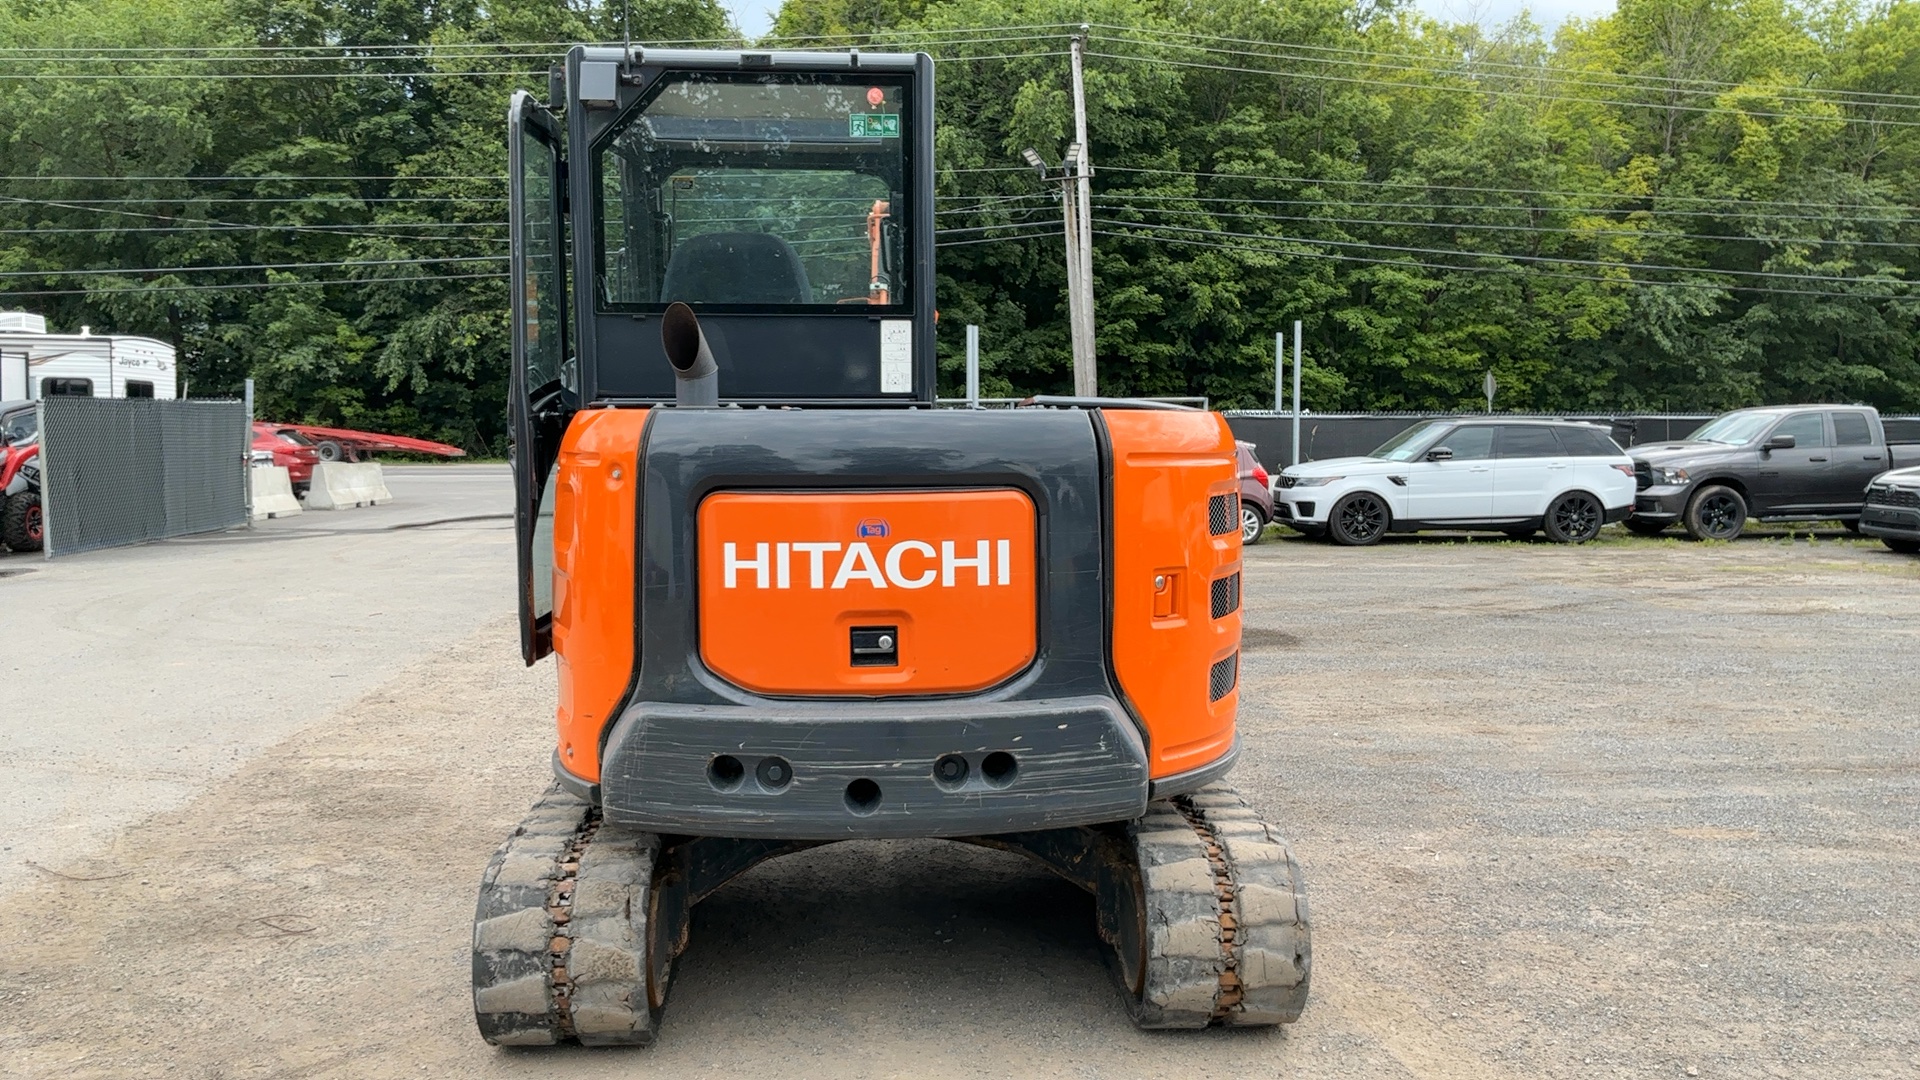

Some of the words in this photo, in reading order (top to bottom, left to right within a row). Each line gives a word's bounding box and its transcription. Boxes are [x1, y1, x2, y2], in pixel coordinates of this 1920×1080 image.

[119, 356, 140, 368] Jayco
[866, 525, 881, 535] Tag
[723, 540, 1011, 589] HITACHI
